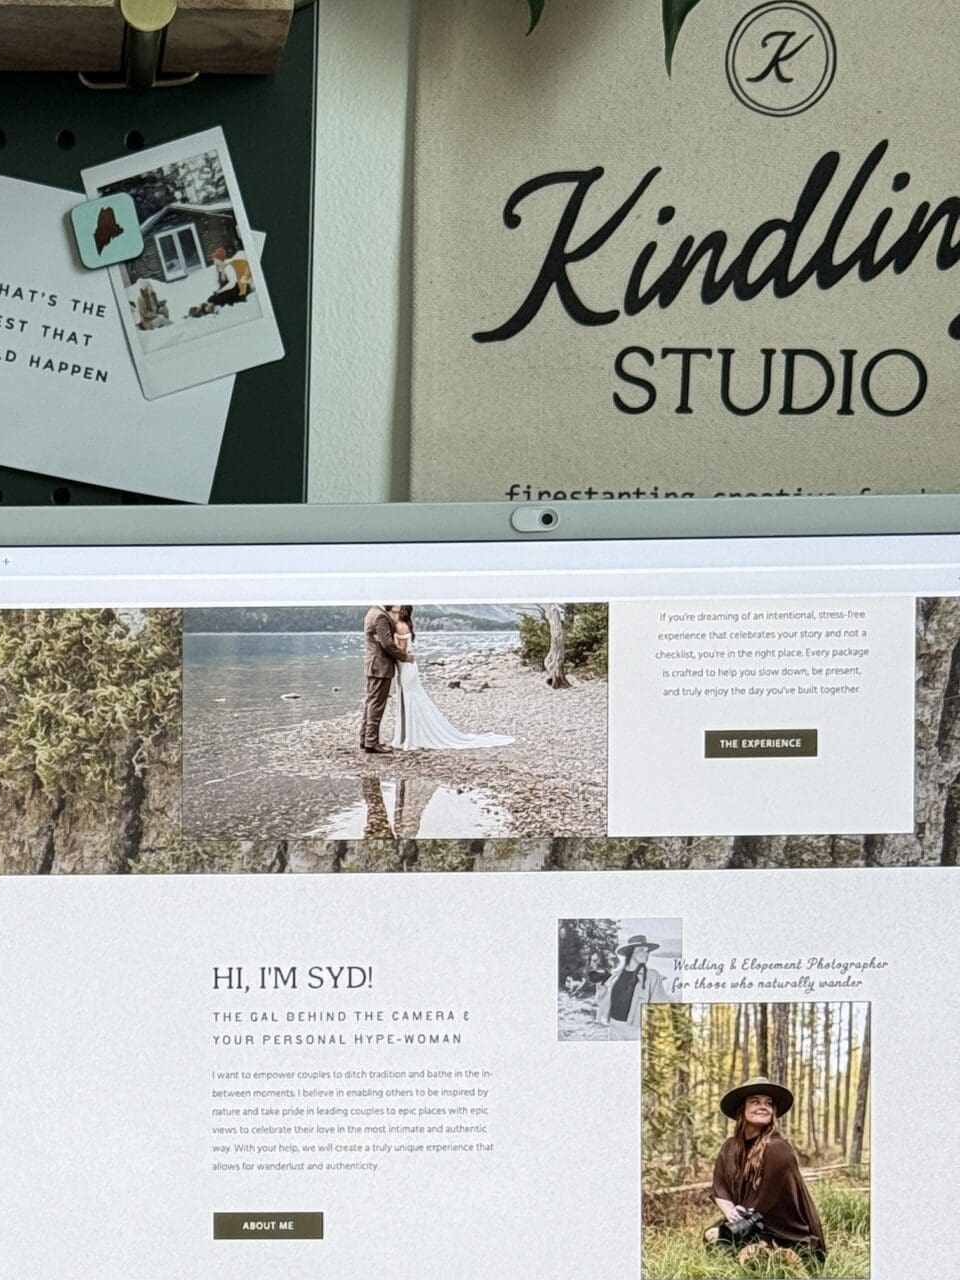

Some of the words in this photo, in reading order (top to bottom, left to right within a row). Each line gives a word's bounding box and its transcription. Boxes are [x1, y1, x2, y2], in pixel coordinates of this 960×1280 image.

[745, 31, 814, 84] K
[471, 138, 960, 344] Kindlin
[71, 299, 107, 318] THE
[41, 324, 93, 347] THAT
[29, 355, 109, 383] HAPPEN
[613, 345, 928, 417] STUDIO
[659, 613, 666, 622] If
[667, 612, 696, 624] you're
[697, 612, 739, 623] dreaming
[741, 611, 752, 620] of
[766, 611, 816, 622] intentional,
[818, 610, 866, 619] stress-free
[657, 631, 707, 642] experience
[708, 631, 727, 640] that
[729, 630, 776, 639] celebrates
[777, 632, 798, 641] your
[800, 629, 823, 641] story
[824, 629, 842, 638] and
[843, 629, 859, 638] not
[697, 649, 726, 661] you're
[727, 649, 736, 658] in
[738, 649, 753, 658] the
[754, 649, 776, 660] right
[777, 648, 804, 660] place.
[805, 648, 830, 659] Every
[832, 647, 870, 659] package
[662, 668, 670, 677] is
[671, 668, 704, 677] crafted
[705, 668, 716, 677] to
[718, 668, 738, 679] help
[739, 670, 757, 679] you
[758, 667, 780, 676] slow
[781, 667, 809, 678] down,
[811, 667, 823, 676] be
[825, 666, 862, 678] present,
[662, 687, 680, 696] and
[682, 687, 702, 698] truly
[704, 687, 729, 698] enjoy
[731, 687, 746, 696] the
[748, 686, 765, 698] day
[766, 686, 796, 697] you've
[798, 686, 818, 695] built
[820, 685, 862, 697] together.
[720, 739, 739, 749] THE
[741, 738, 802, 748] EXPERIENCE
[673, 958, 725, 976] Wedding
[729, 959, 738, 970] &
[741, 957, 803, 975] Elopement
[807, 957, 889, 975] Photographer
[212, 966, 250, 993] HI,
[259, 966, 298, 989] I'M
[307, 966, 373, 989] SYD!
[671, 978, 691, 993] for
[694, 977, 728, 990] those
[730, 977, 755, 989] who
[757, 976, 816, 995] naturally
[818, 977, 863, 989] wander
[212, 1012, 242, 1022] THE
[250, 1012, 279, 1022] GAL
[286, 1011, 347, 1022] BEHIND
[354, 1011, 384, 1022] THE
[391, 1011, 455, 1021] CAMERA
[212, 1035, 255, 1045] YOUR
[262, 1034, 347, 1045] PERSONAL
[354, 1034, 462, 1044] HYPE-WOMAN
[216, 1070, 240, 1079] want
[241, 1070, 251, 1079] to
[253, 1072, 295, 1081] empower
[297, 1070, 331, 1081] couples
[333, 1070, 343, 1079] to
[344, 1070, 367, 1079] ditch
[369, 1070, 407, 1079] tradition
[408, 1069, 425, 1078] and
[427, 1069, 453, 1078] bathe
[454, 1069, 463, 1078] in
[464, 1069, 480, 1078] the
[481, 1069, 494, 1078] in-
[212, 1089, 251, 1098] between
[302, 1088, 335, 1097] believe
[336, 1088, 344, 1097] in
[346, 1088, 384, 1099] enabling
[385, 1088, 414, 1097] others
[416, 1088, 426, 1097] to
[427, 1088, 439, 1097] be
[440, 1088, 475, 1099] inspired
[477, 1088, 489, 1099] by
[242, 1221, 276, 1230] ABOUT
[279, 1221, 294, 1230] ME
